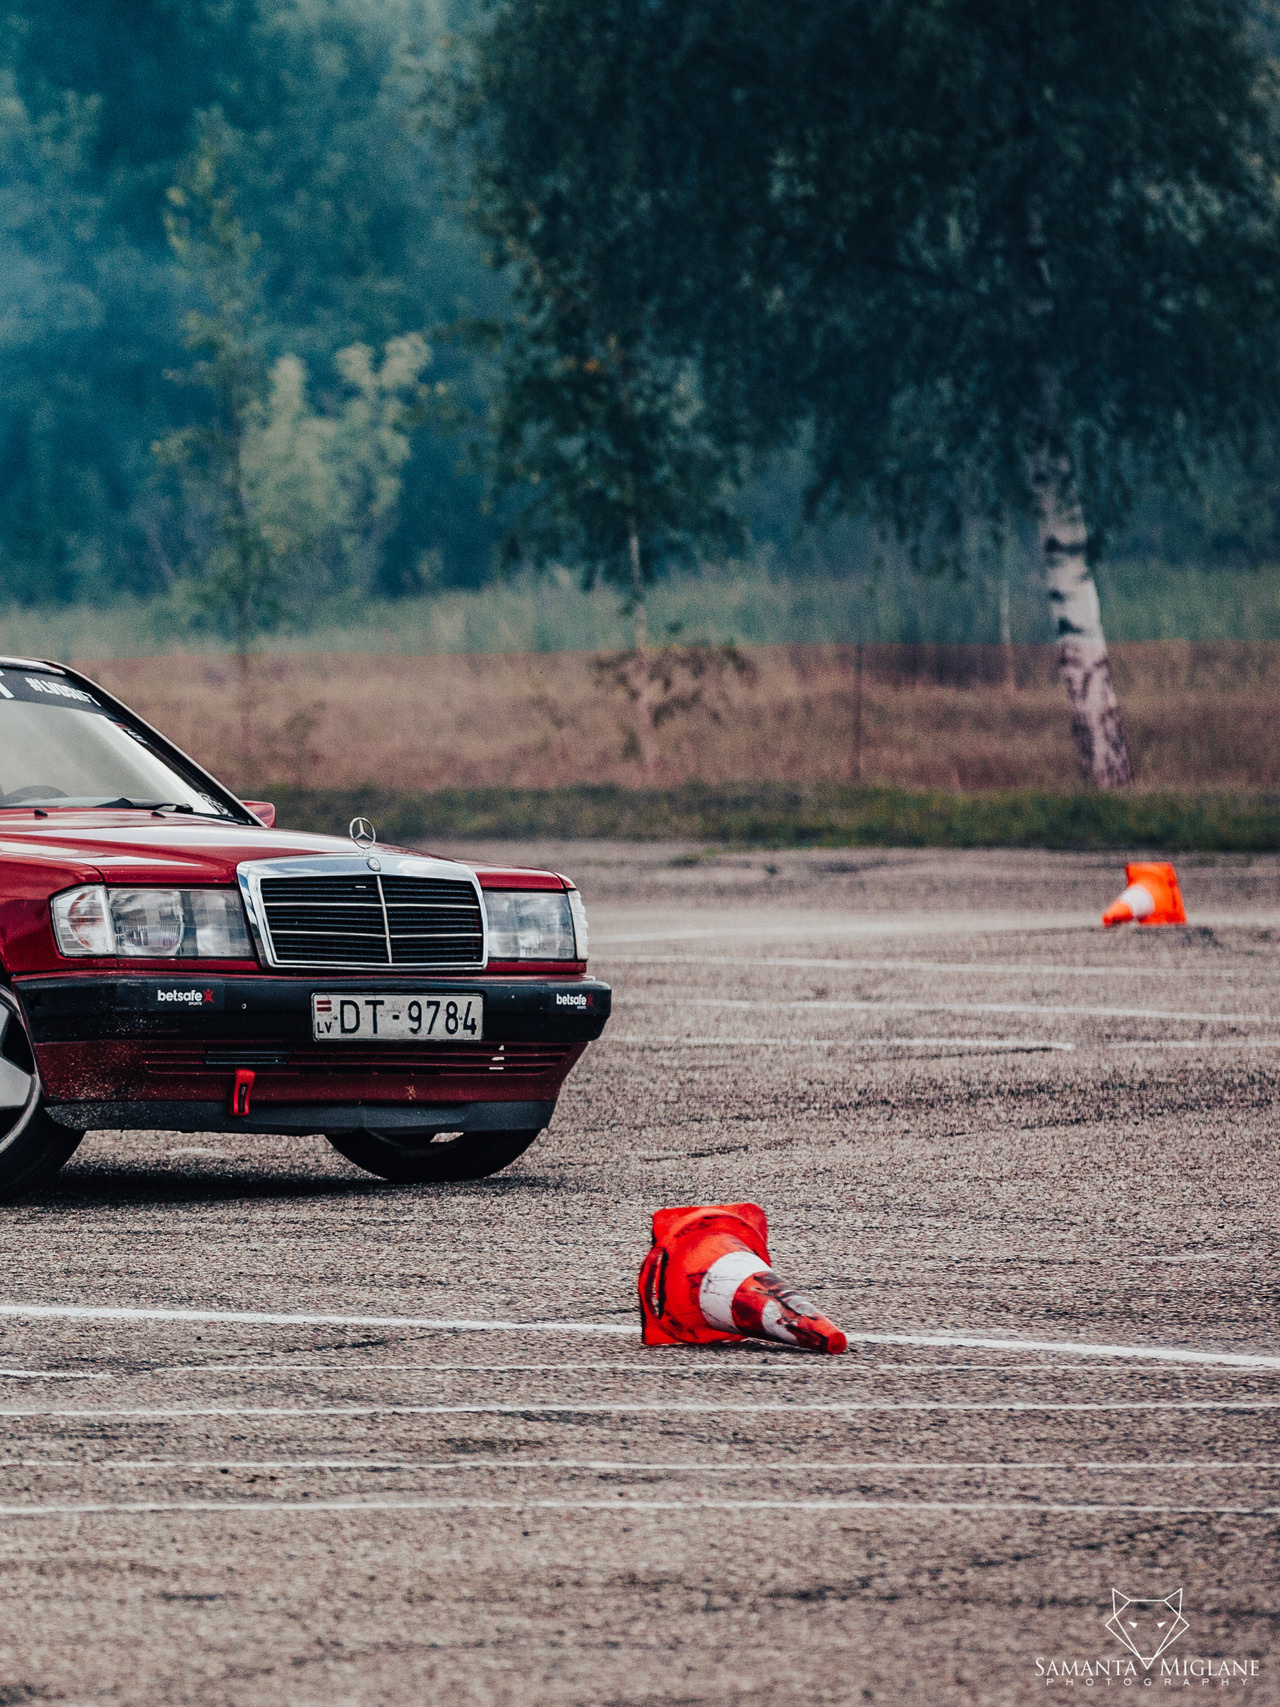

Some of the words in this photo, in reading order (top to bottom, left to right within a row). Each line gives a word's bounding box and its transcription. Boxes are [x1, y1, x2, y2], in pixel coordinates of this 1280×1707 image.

[157, 989, 203, 1002] betsafe
[556, 993, 587, 1006] betsafe
[316, 1021, 332, 1034] LV
